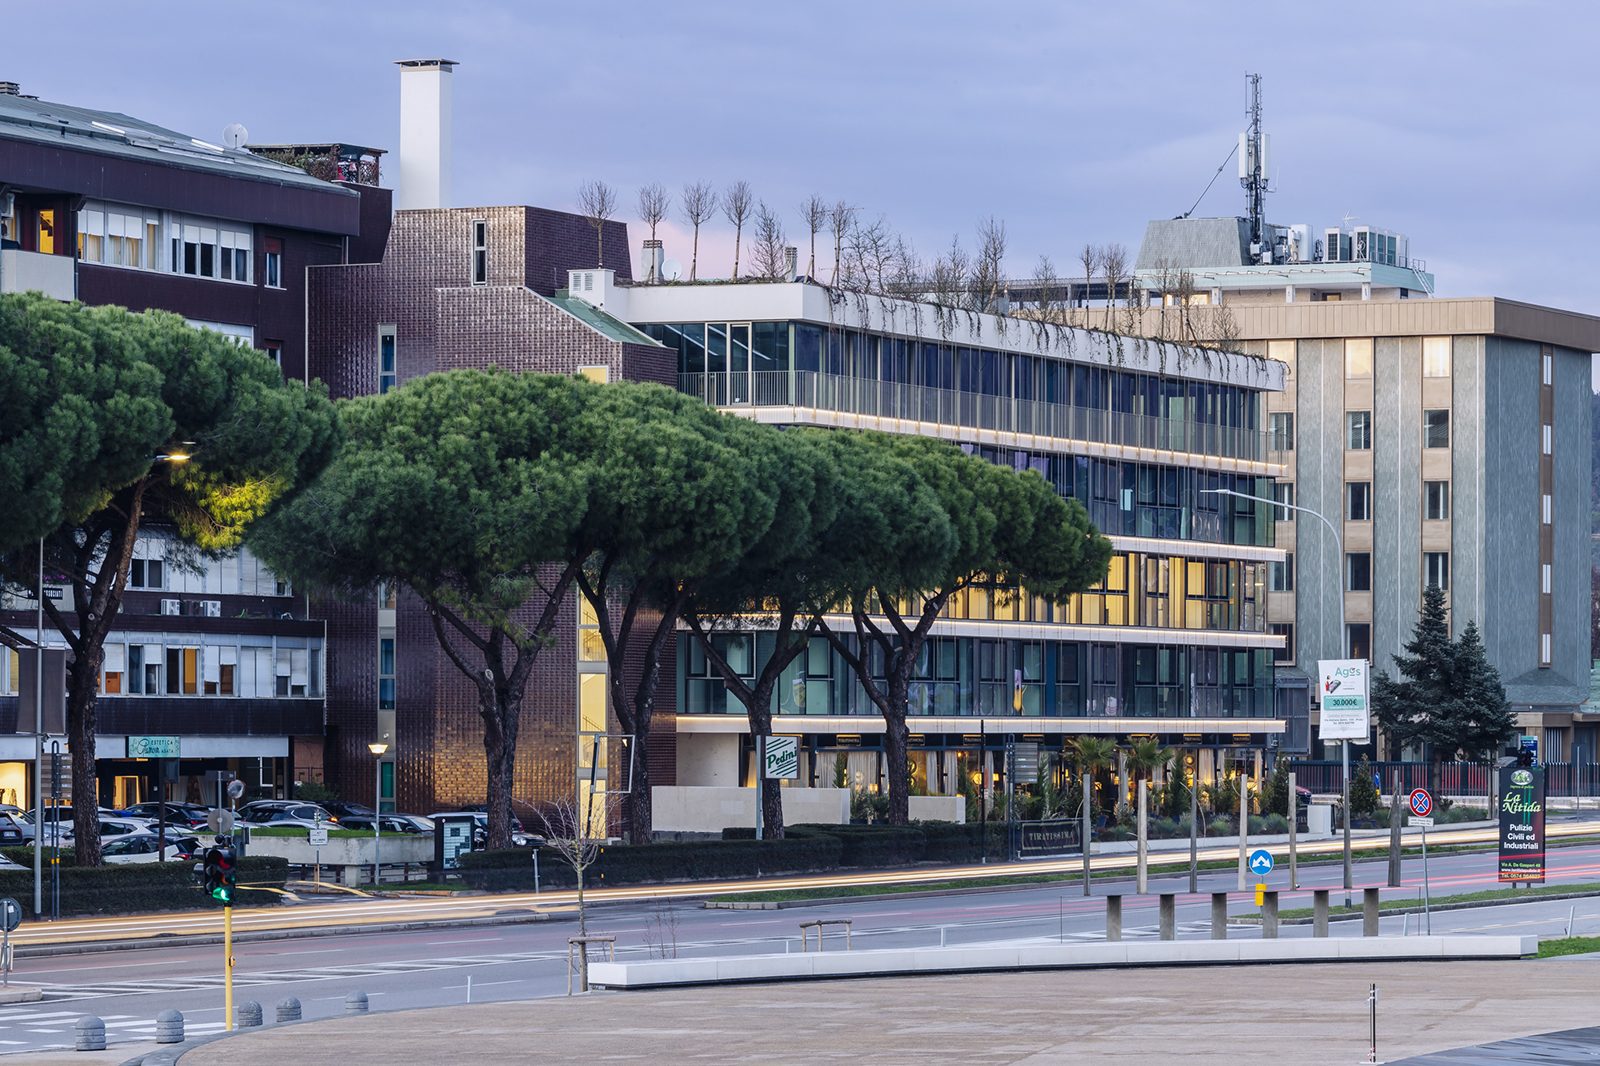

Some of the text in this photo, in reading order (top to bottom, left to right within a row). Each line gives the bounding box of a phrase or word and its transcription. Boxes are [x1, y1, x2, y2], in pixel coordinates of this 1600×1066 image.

[1335, 667, 1361, 678] Agos
[1333, 698, 1357, 706] 30.000€
[767, 746, 797, 769] Pedini
[1503, 792, 1521, 802] La
[1502, 801, 1541, 814] Nitida
